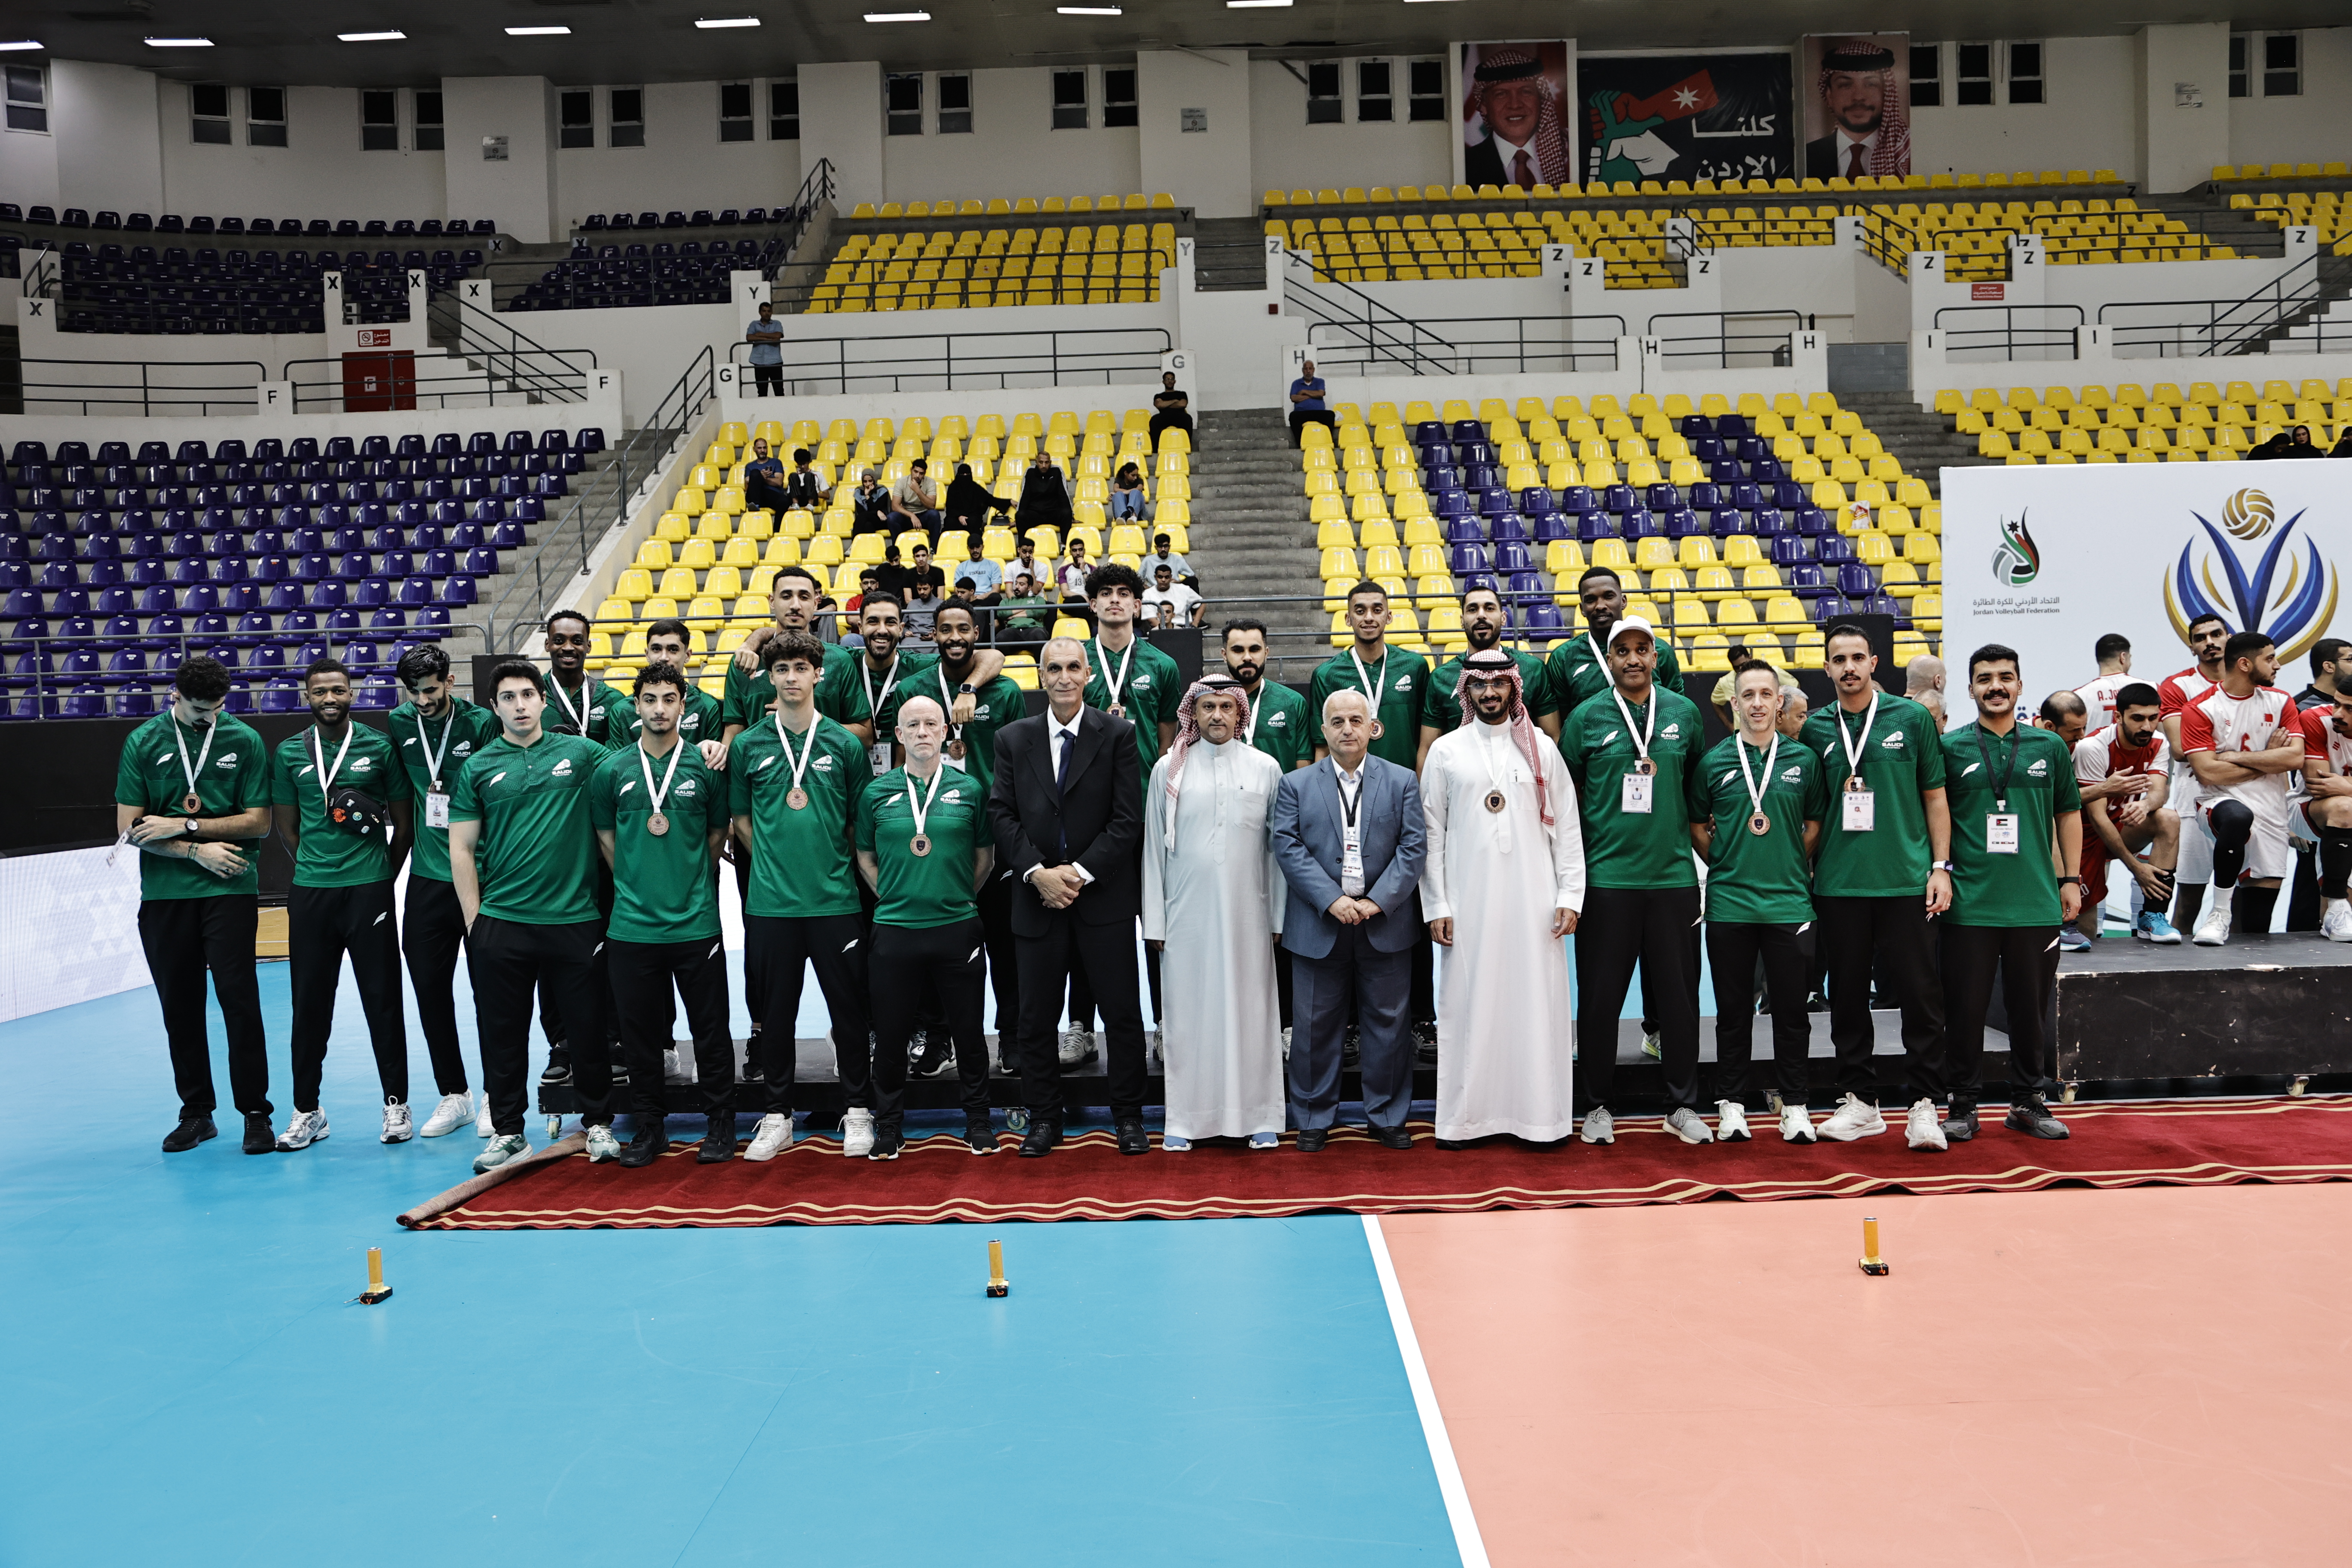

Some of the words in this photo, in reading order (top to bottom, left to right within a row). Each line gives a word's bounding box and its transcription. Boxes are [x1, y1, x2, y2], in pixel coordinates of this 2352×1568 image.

[2127, 186, 2136, 198] Z
[1180, 210, 1190, 222] Y
[1264, 208, 1273, 220] Z
[2296, 230, 2306, 243] Z
[493, 240, 502, 251] X
[1180, 242, 1191, 256] Y
[1269, 240, 1280, 254] Z
[1553, 248, 1563, 261] Z
[2024, 251, 2034, 264] Z
[1583, 263, 1593, 276] Z
[1699, 260, 1709, 273] Z
[1923, 256, 1934, 270] Z
[327, 276, 338, 290] X
[409, 274, 421, 288] X
[468, 284, 479, 297] X
[749, 286, 759, 300] Y
[29, 301, 43, 316] X
[1646, 340, 1657, 354] H
[1804, 335, 1815, 349] H
[1172, 355, 1185, 369] G
[1293, 349, 1305, 364] H
[720, 368, 732, 382] G
[599, 376, 608, 389] F
[268, 390, 277, 404] F
[1997, 598, 2013, 606] للكرة
